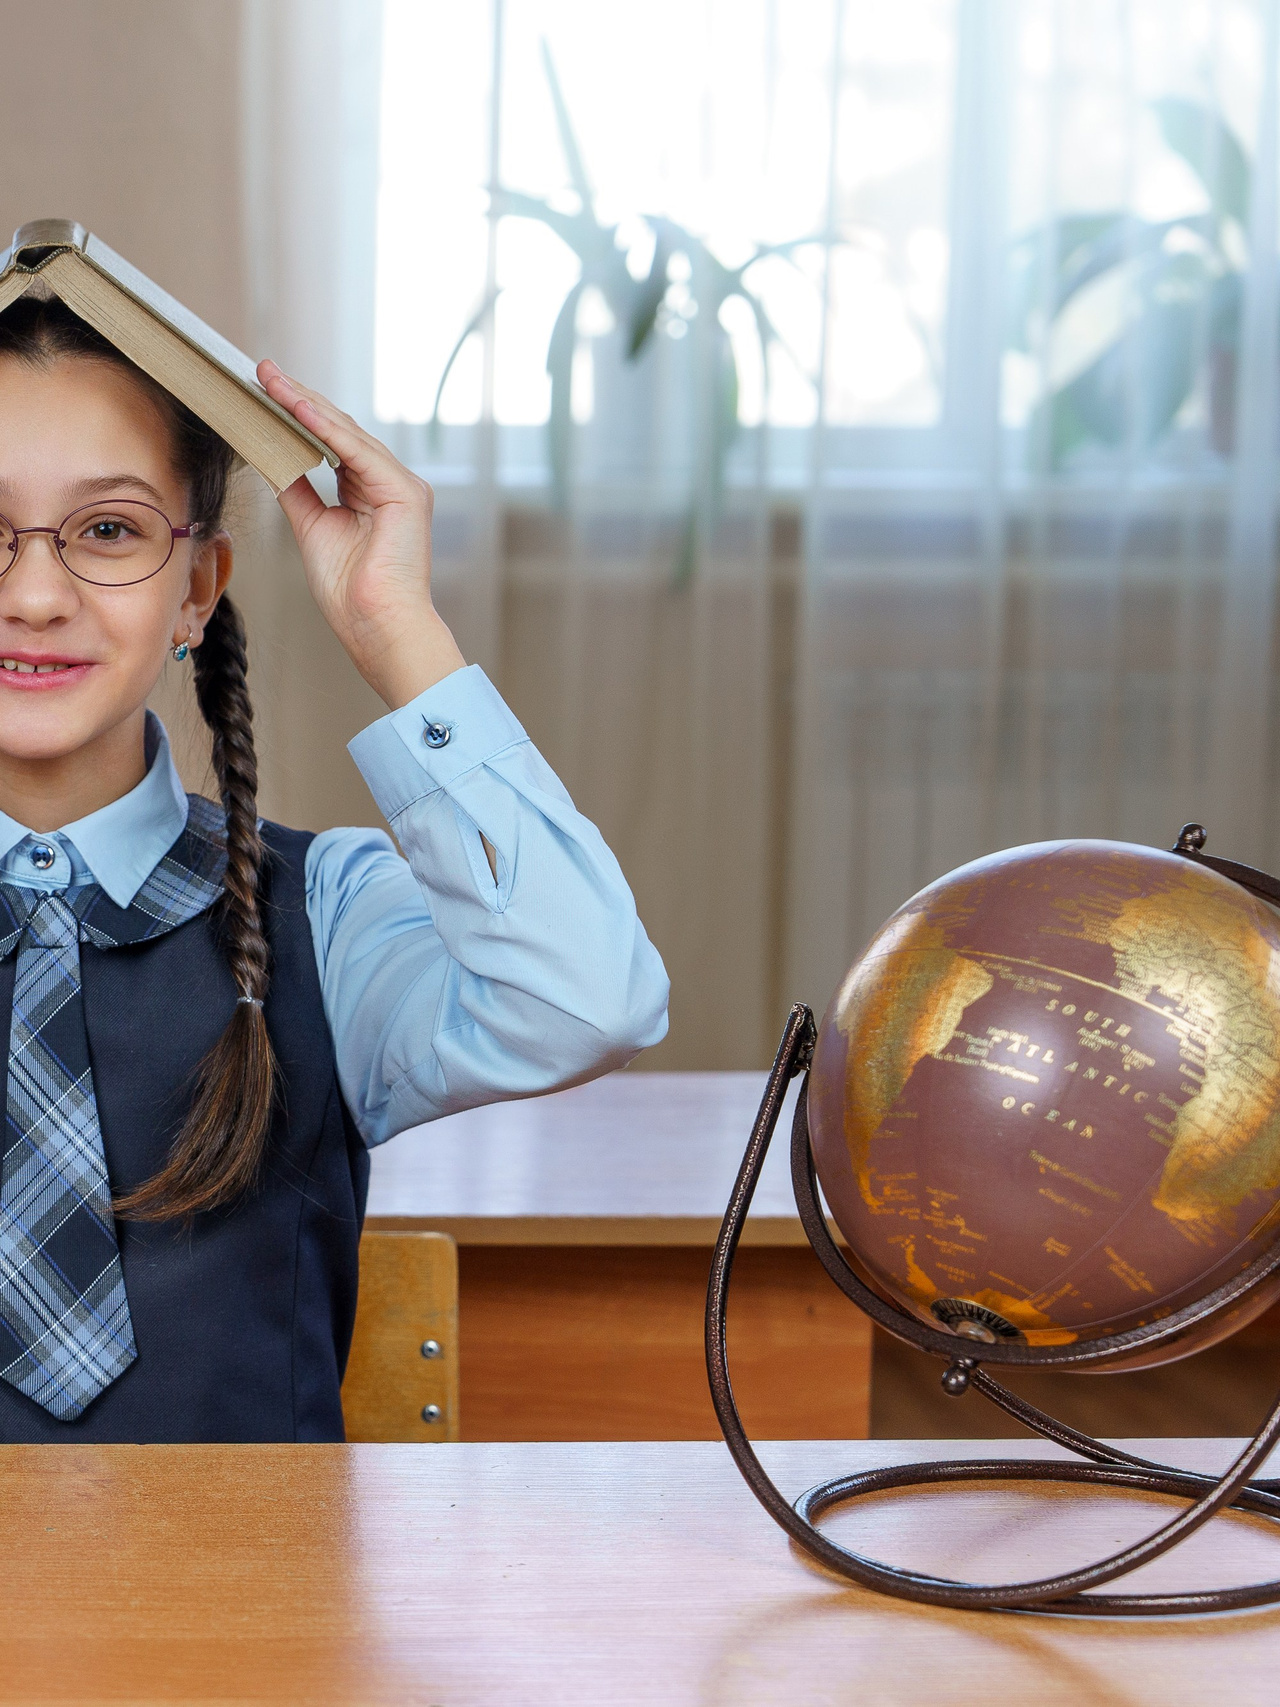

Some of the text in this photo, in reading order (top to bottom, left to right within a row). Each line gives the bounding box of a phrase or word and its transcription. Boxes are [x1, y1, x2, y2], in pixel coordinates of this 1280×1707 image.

[1045, 999, 1132, 1037] SOUTH
[1006, 1041, 1149, 1103] ATLANTIC
[1002, 1096, 1094, 1138] OCEAN
